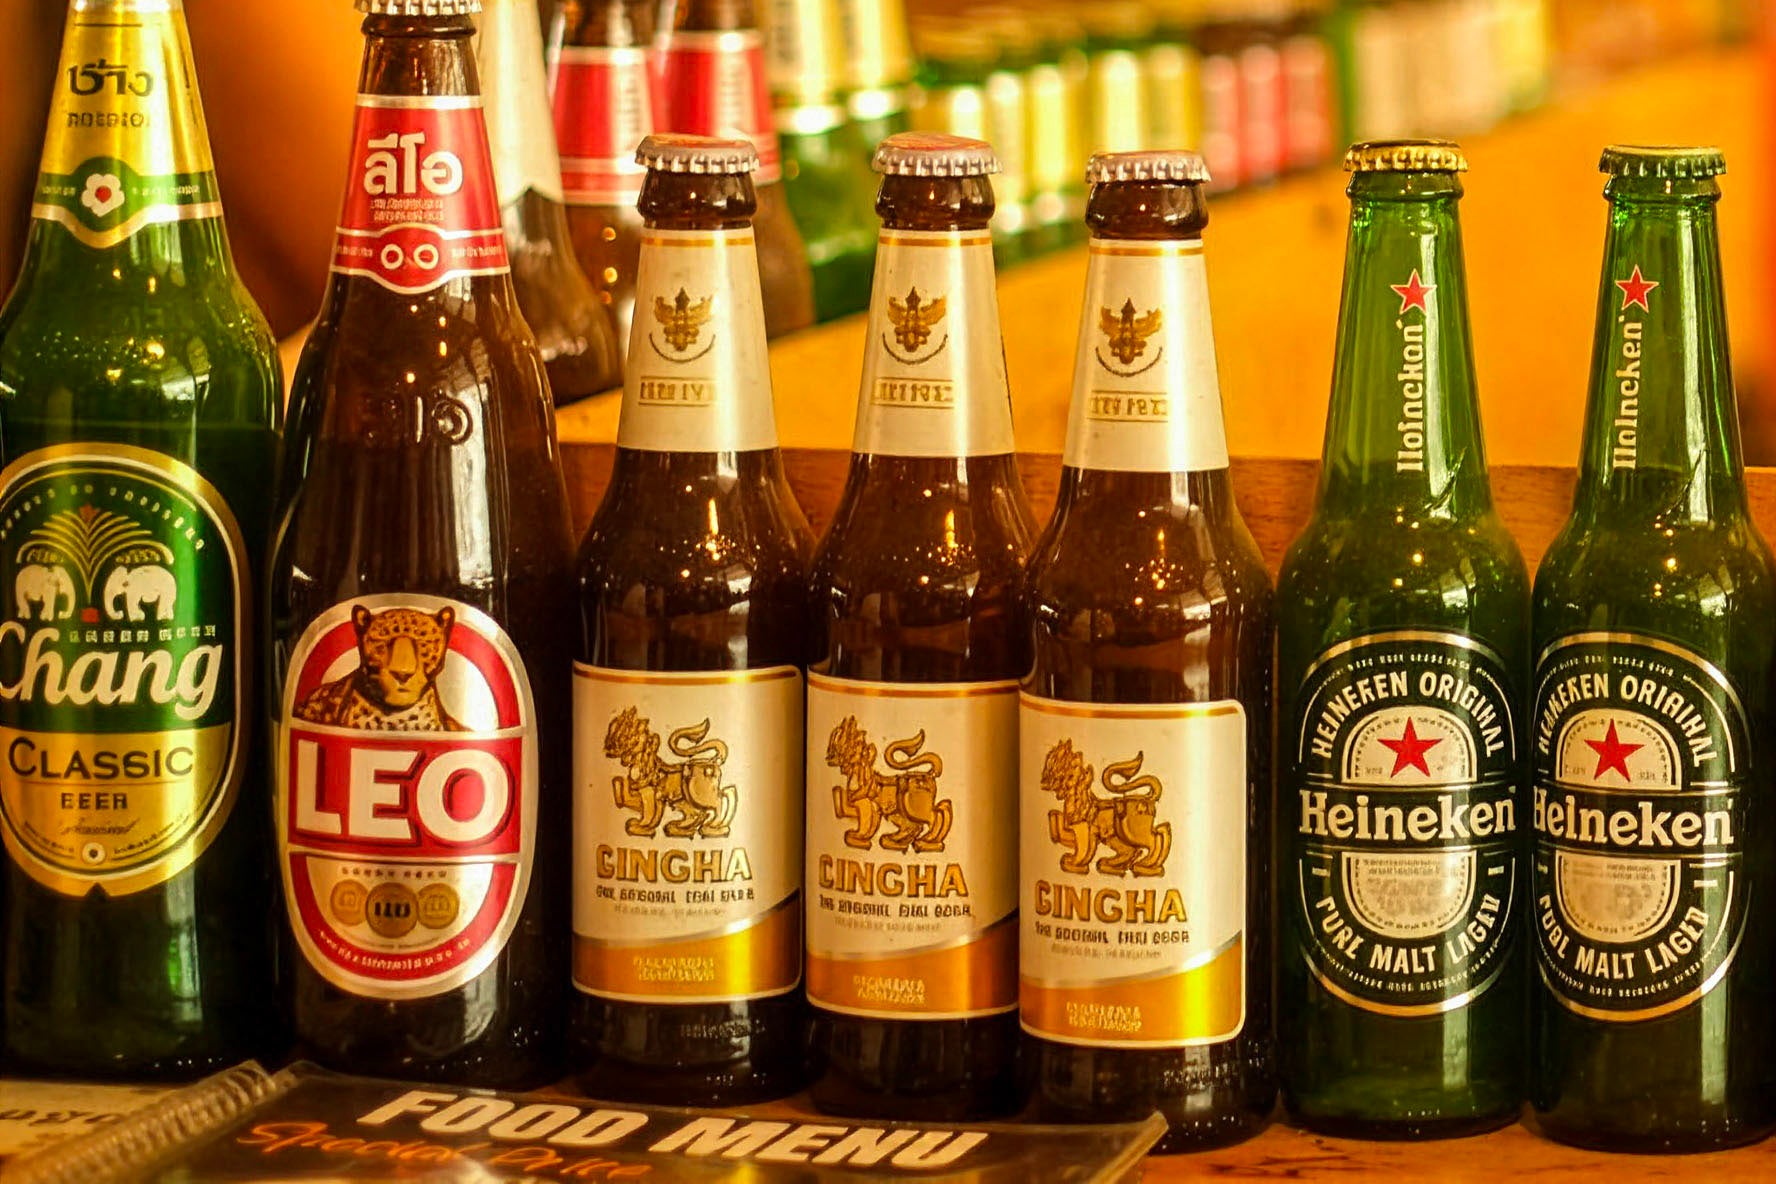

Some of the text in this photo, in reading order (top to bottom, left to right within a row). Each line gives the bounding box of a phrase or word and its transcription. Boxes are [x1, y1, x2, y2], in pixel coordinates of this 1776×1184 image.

[363, 132, 463, 196] ลีโอ
[0, 620, 223, 721] Chang
[296, 739, 509, 842] LEO
[1298, 788, 1517, 842] Heineken
[1533, 785, 1735, 847] Heineken
[1369, 943, 1437, 975] MALT
[1574, 945, 1636, 980] MALT
[356, 1089, 989, 1170] FOOD MENU
